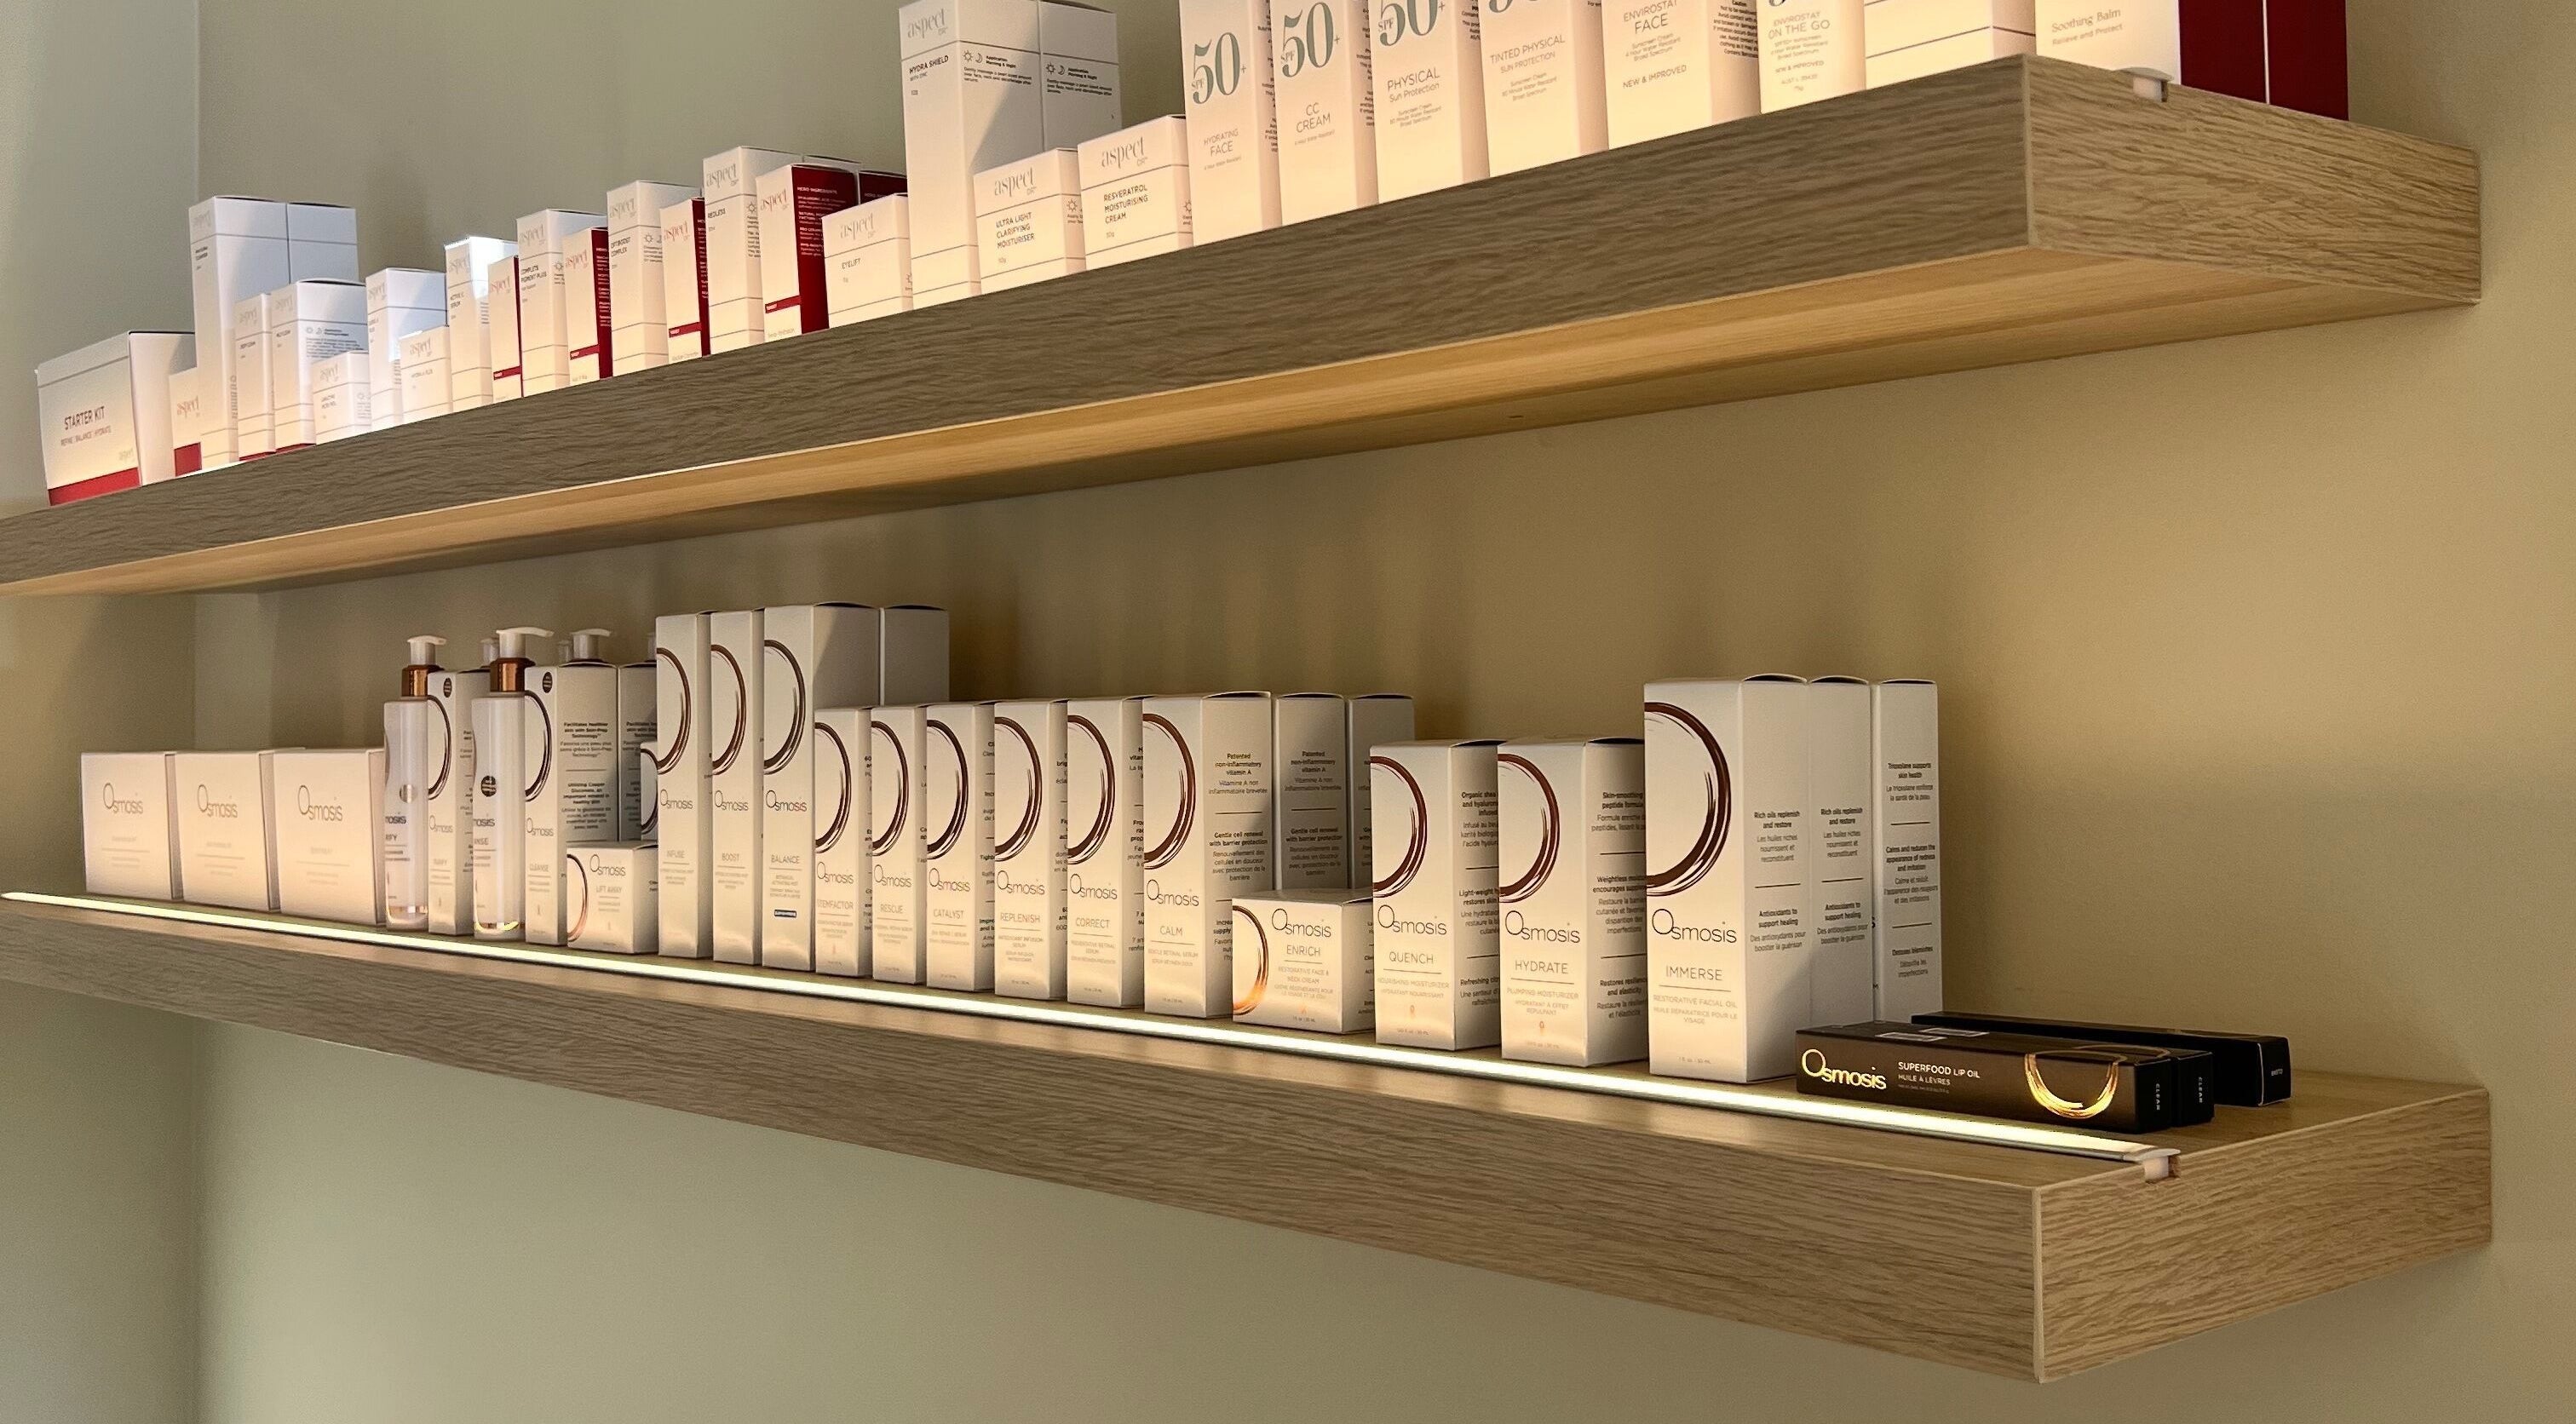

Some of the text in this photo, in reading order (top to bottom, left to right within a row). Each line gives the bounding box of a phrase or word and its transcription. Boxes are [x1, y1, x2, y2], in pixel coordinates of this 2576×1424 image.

[907, 8, 946, 39] aspect
[1377, 18, 1394, 32] SPF
[1635, 13, 1669, 34] FACE
[1768, 20, 1830, 39] ON THE GO
[2051, 9, 2121, 33] Soothing Balm
[1281, 50, 1295, 64] SPF
[1489, 34, 1565, 64] TINTED PHYSICAL
[1515, 51, 1555, 68] PROTECTION
[1387, 66, 1440, 92] PHYSICAL
[1623, 78, 1640, 89] NEW
[1648, 64, 1688, 82] IMPROVED
[1389, 83, 1440, 103] Sun Protection
[1305, 102, 1320, 116] CC
[1296, 112, 1331, 133] CREAM
[1204, 128, 1239, 146] HYDRATING
[1101, 136, 1144, 169] aspect
[1210, 141, 1233, 157] FACE
[706, 163, 737, 189] aspect
[994, 166, 1033, 198] aspect
[760, 186, 788, 212] aspect
[1103, 183, 1148, 203] RESVERATROL
[1104, 194, 1148, 214] MOISTURISING
[839, 212, 874, 240] aspect
[995, 211, 1032, 229] ULTRA LIGHT
[1105, 213, 1127, 225] CREAM
[996, 223, 1031, 239] CLARIFYING
[997, 233, 1035, 250] MOISTURISER
[64, 405, 106, 430] STARTER KIT
[102, 782, 144, 815] Osmosis
[197, 783, 239, 819] Osmosis
[296, 784, 343, 823] Osmosis
[659, 789, 693, 810] Osmosis
[714, 790, 749, 811] Osmosis
[765, 790, 808, 812] Osmosis
[589, 853, 627, 877] Osmosis
[770, 854, 801, 864] BALANCE
[816, 861, 854, 885] Osmosis
[873, 864, 912, 888] Osmosis
[929, 867, 971, 893] Osmosis
[996, 870, 1045, 895] Osmosis
[1069, 873, 1118, 900] Osmosis
[1146, 878, 1199, 907] Osmosis
[880, 903, 904, 914] RESCUE
[933, 909, 964, 920] CATALYST
[999, 912, 1041, 923] REPLENISH
[1075, 917, 1111, 930] CORRECT
[1271, 908, 1332, 938] Osmosis
[1377, 904, 1447, 935] Osmosis
[1504, 910, 1581, 944] Osmosis
[1651, 908, 1738, 944] Osmosis
[1159, 925, 1183, 937] CALM
[1286, 945, 1321, 957] ENRICH
[1389, 950, 1434, 965] QUENCH
[1514, 959, 1568, 974] HYDRATE
[1665, 965, 1723, 981] IMMERSE
[1653, 995, 1698, 1006] RESTORATIVE
[1699, 998, 1723, 1008] FACIAL
[1801, 1048, 1887, 1090] Osmosis
[1898, 1061, 1981, 1078] SUPERFOOD LIP OIL
[1898, 1074, 1918, 1082] HUILE
[1918, 1074, 1924, 1083] À
